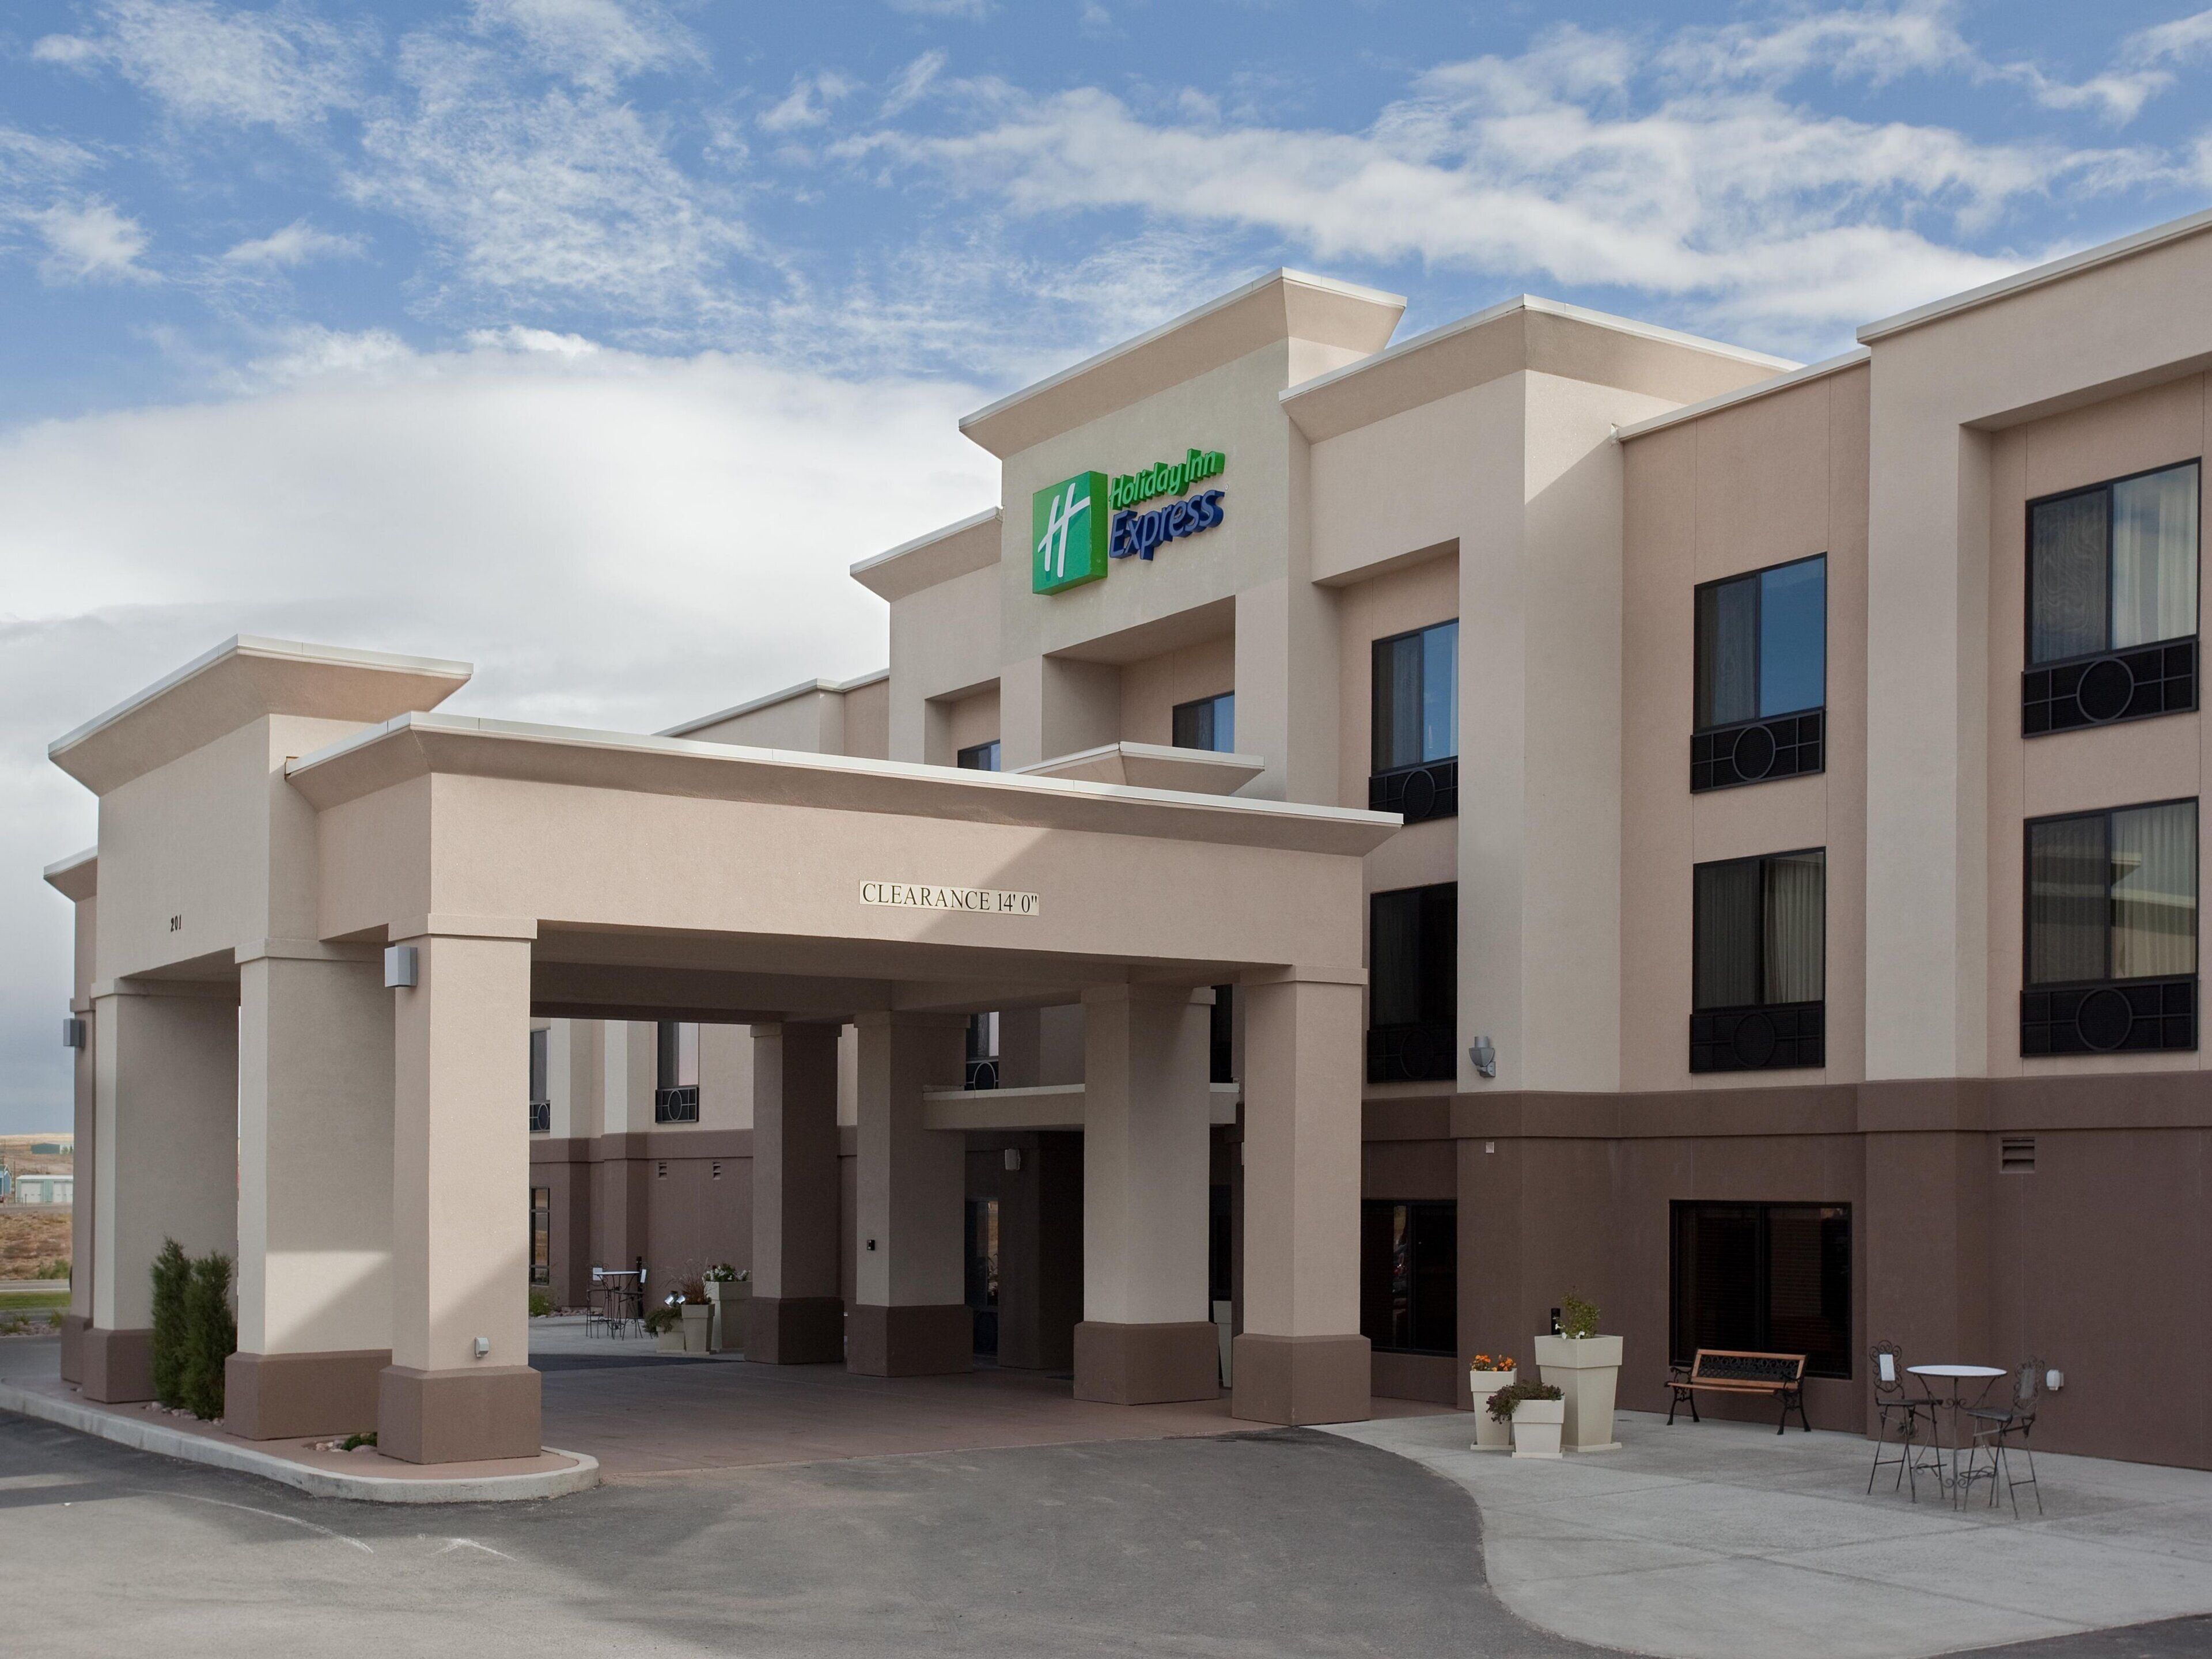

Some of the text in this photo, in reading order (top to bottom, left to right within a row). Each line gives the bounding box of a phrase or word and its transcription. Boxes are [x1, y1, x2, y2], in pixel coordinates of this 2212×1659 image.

[1109, 448, 1225, 510] Holiday Inn
[1109, 490, 1225, 560] Express
[862, 883, 990, 910] CLEARANCE
[171, 914, 181, 932] 201
